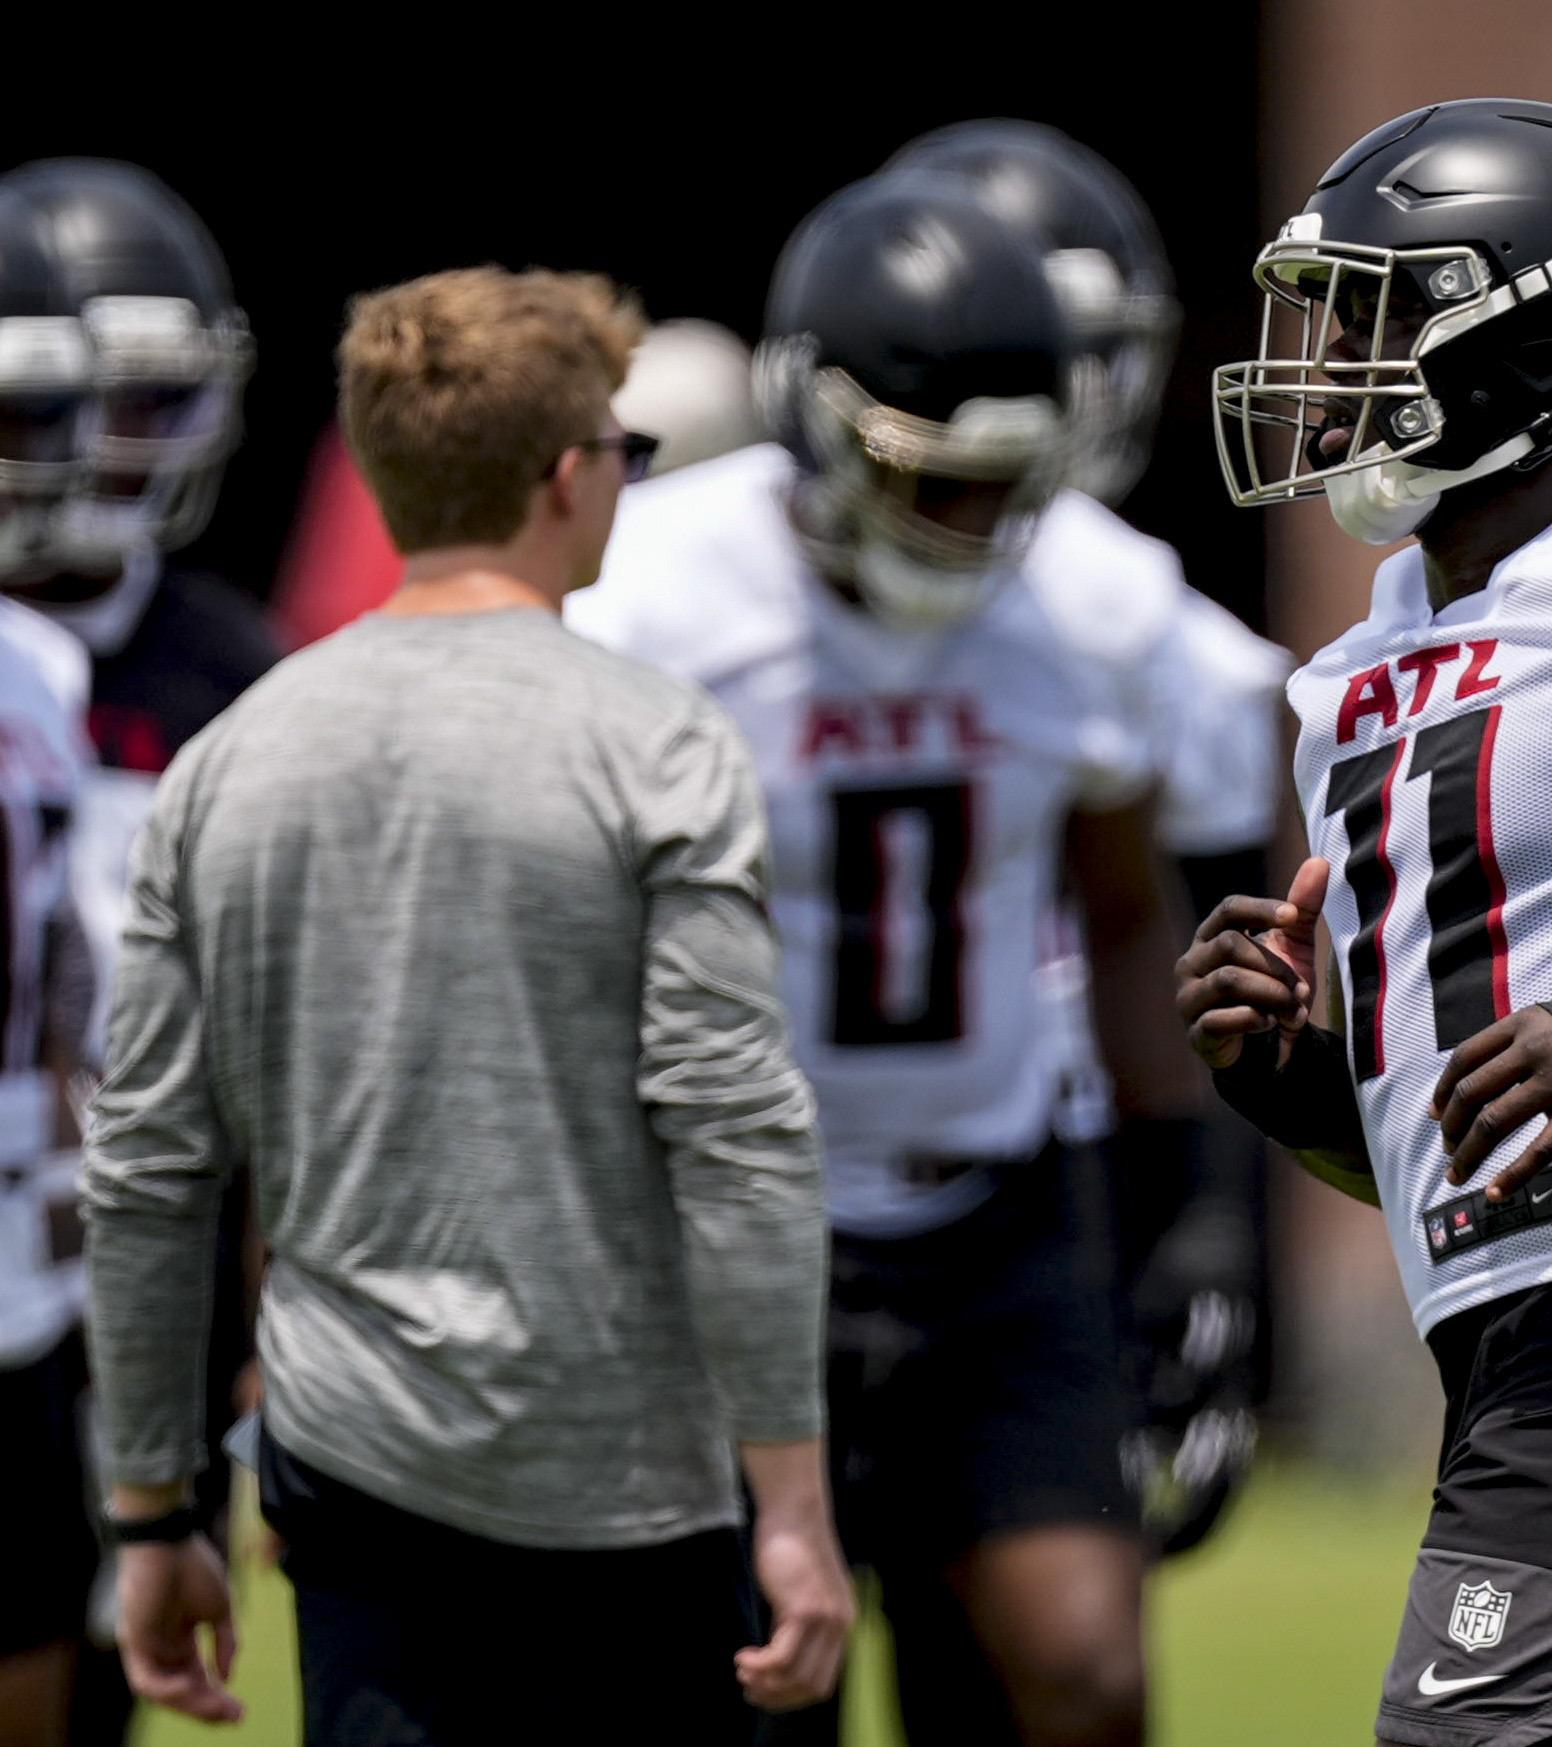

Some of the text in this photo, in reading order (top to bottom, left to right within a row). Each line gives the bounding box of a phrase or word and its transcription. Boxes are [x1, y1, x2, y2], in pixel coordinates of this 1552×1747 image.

[800, 695, 1003, 762] ATL
[1336, 638, 1502, 746] ATL
[832, 775, 974, 1046] 0
[1324, 704, 1512, 1086] 11
[1455, 1608, 1495, 1640] NFL
